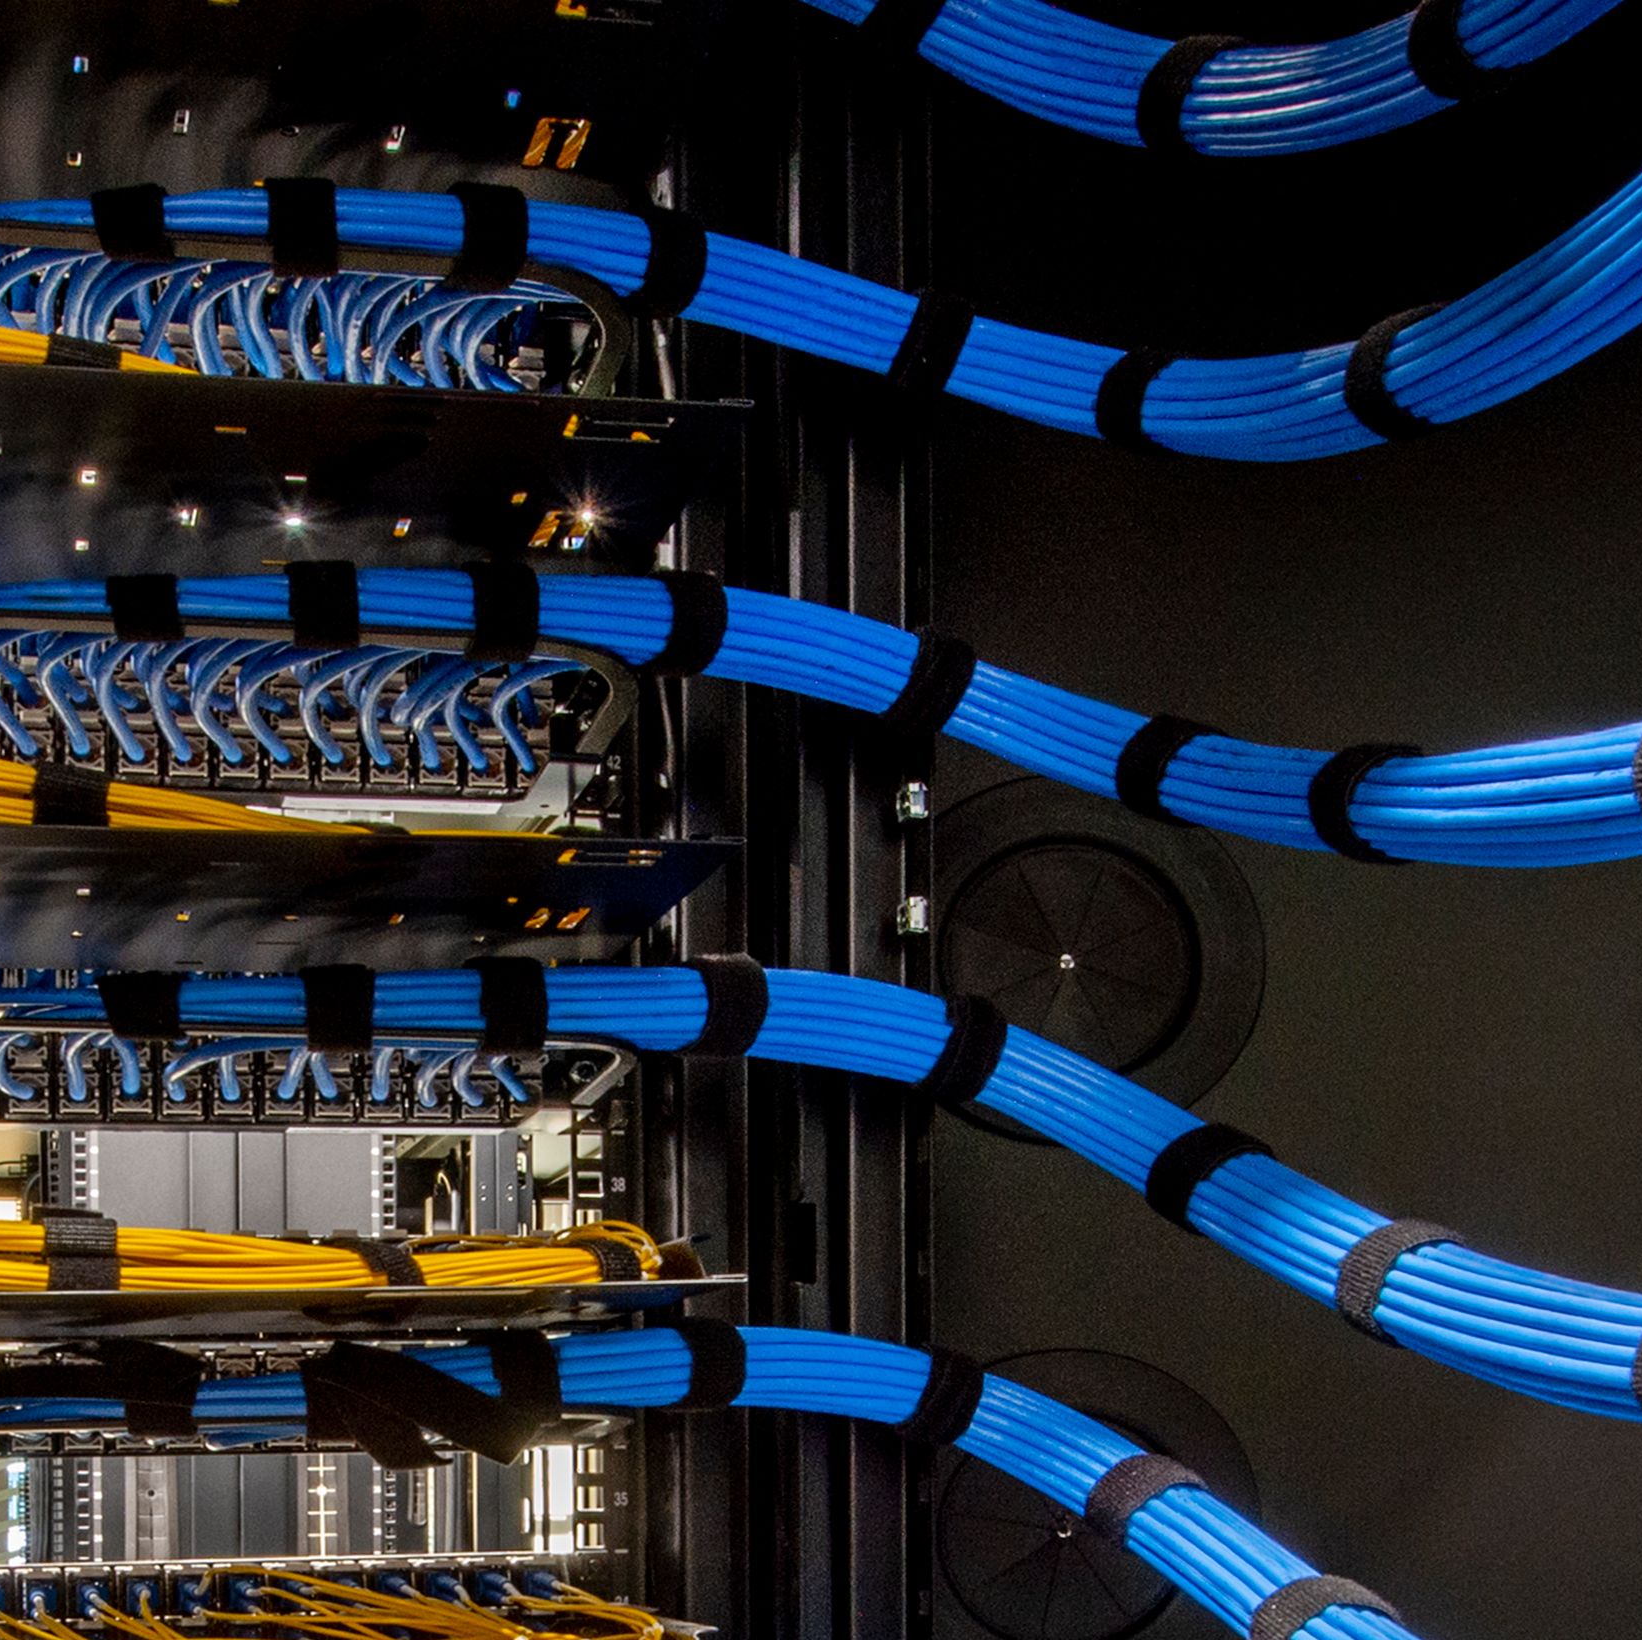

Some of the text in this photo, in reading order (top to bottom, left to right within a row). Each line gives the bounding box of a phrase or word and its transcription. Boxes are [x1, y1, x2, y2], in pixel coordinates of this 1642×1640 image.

[606, 754, 621, 770] 42
[611, 1177, 626, 1193] 38
[613, 1491, 628, 1507] 35
